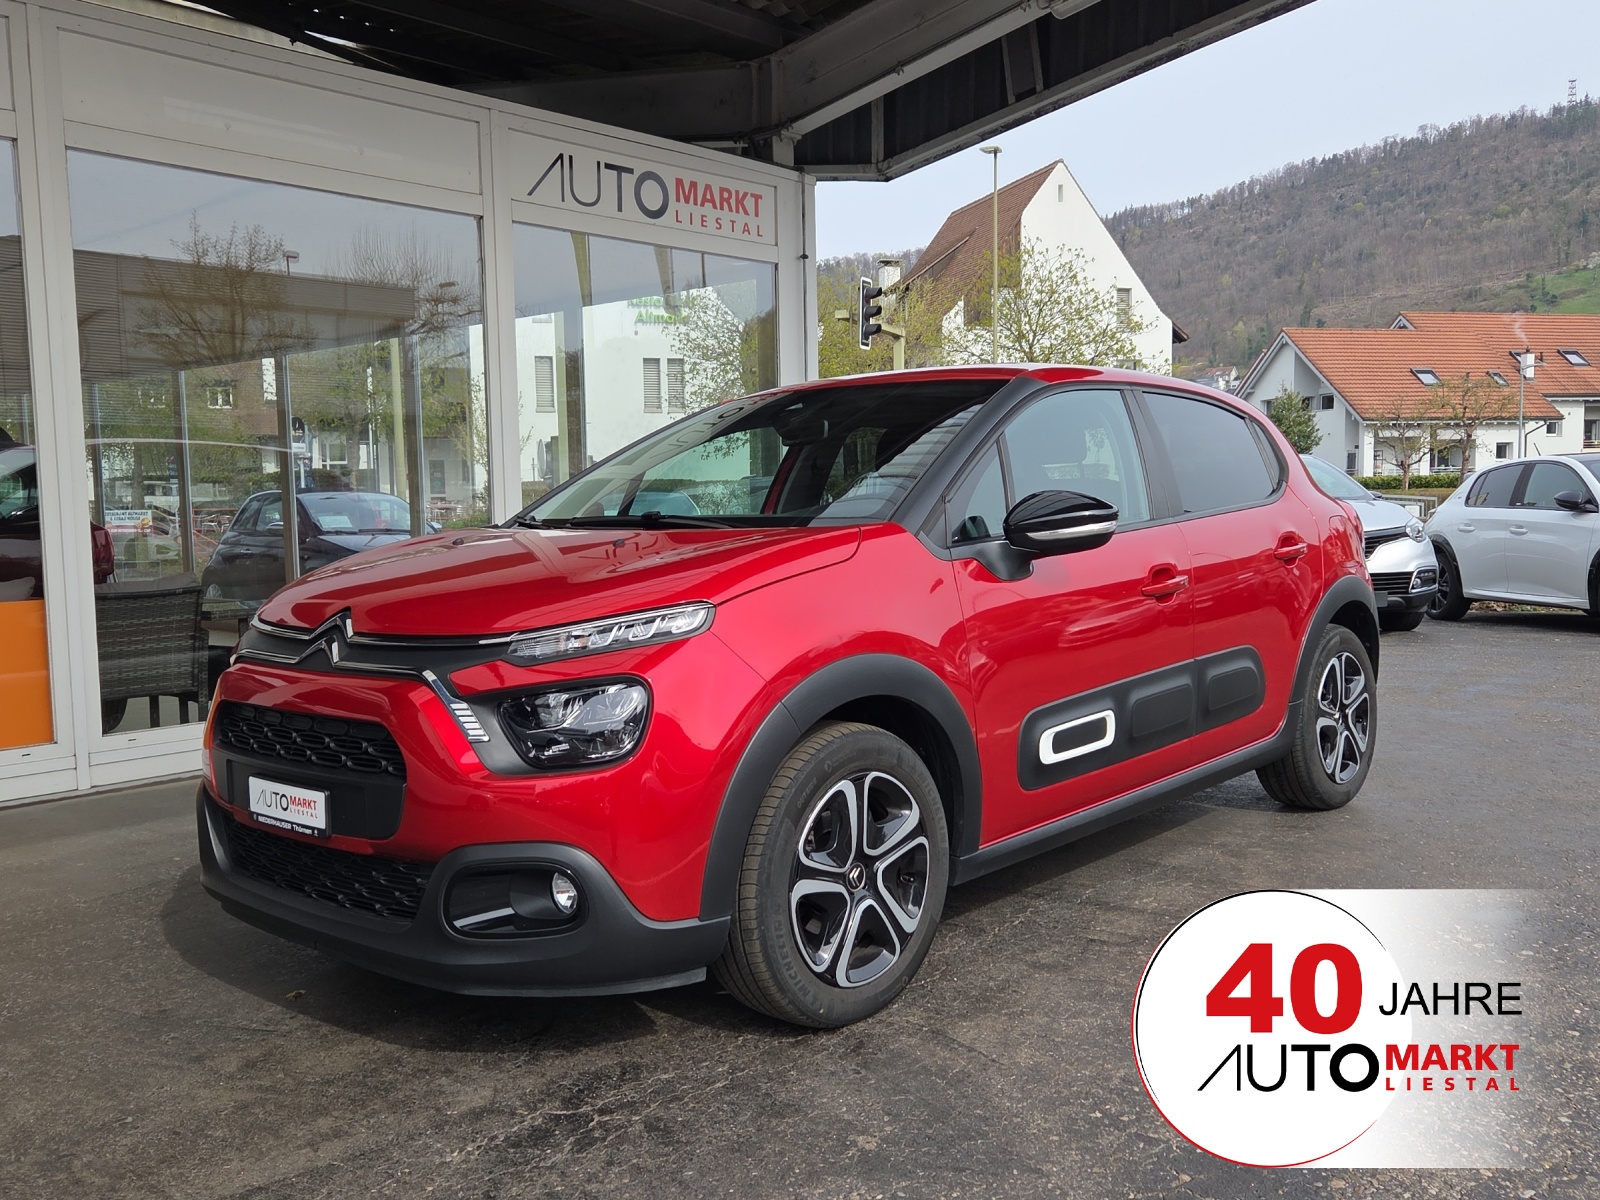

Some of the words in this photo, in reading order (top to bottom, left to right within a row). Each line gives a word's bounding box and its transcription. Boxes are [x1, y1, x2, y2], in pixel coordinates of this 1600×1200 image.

[527, 153, 670, 220] AUTO
[675, 177, 763, 218] MARKT
[675, 210, 763, 238] LIESTAL
[256, 788, 289, 812] AUTO
[289, 795, 317, 811] MARKT
[289, 808, 318, 819] LIESTAL
